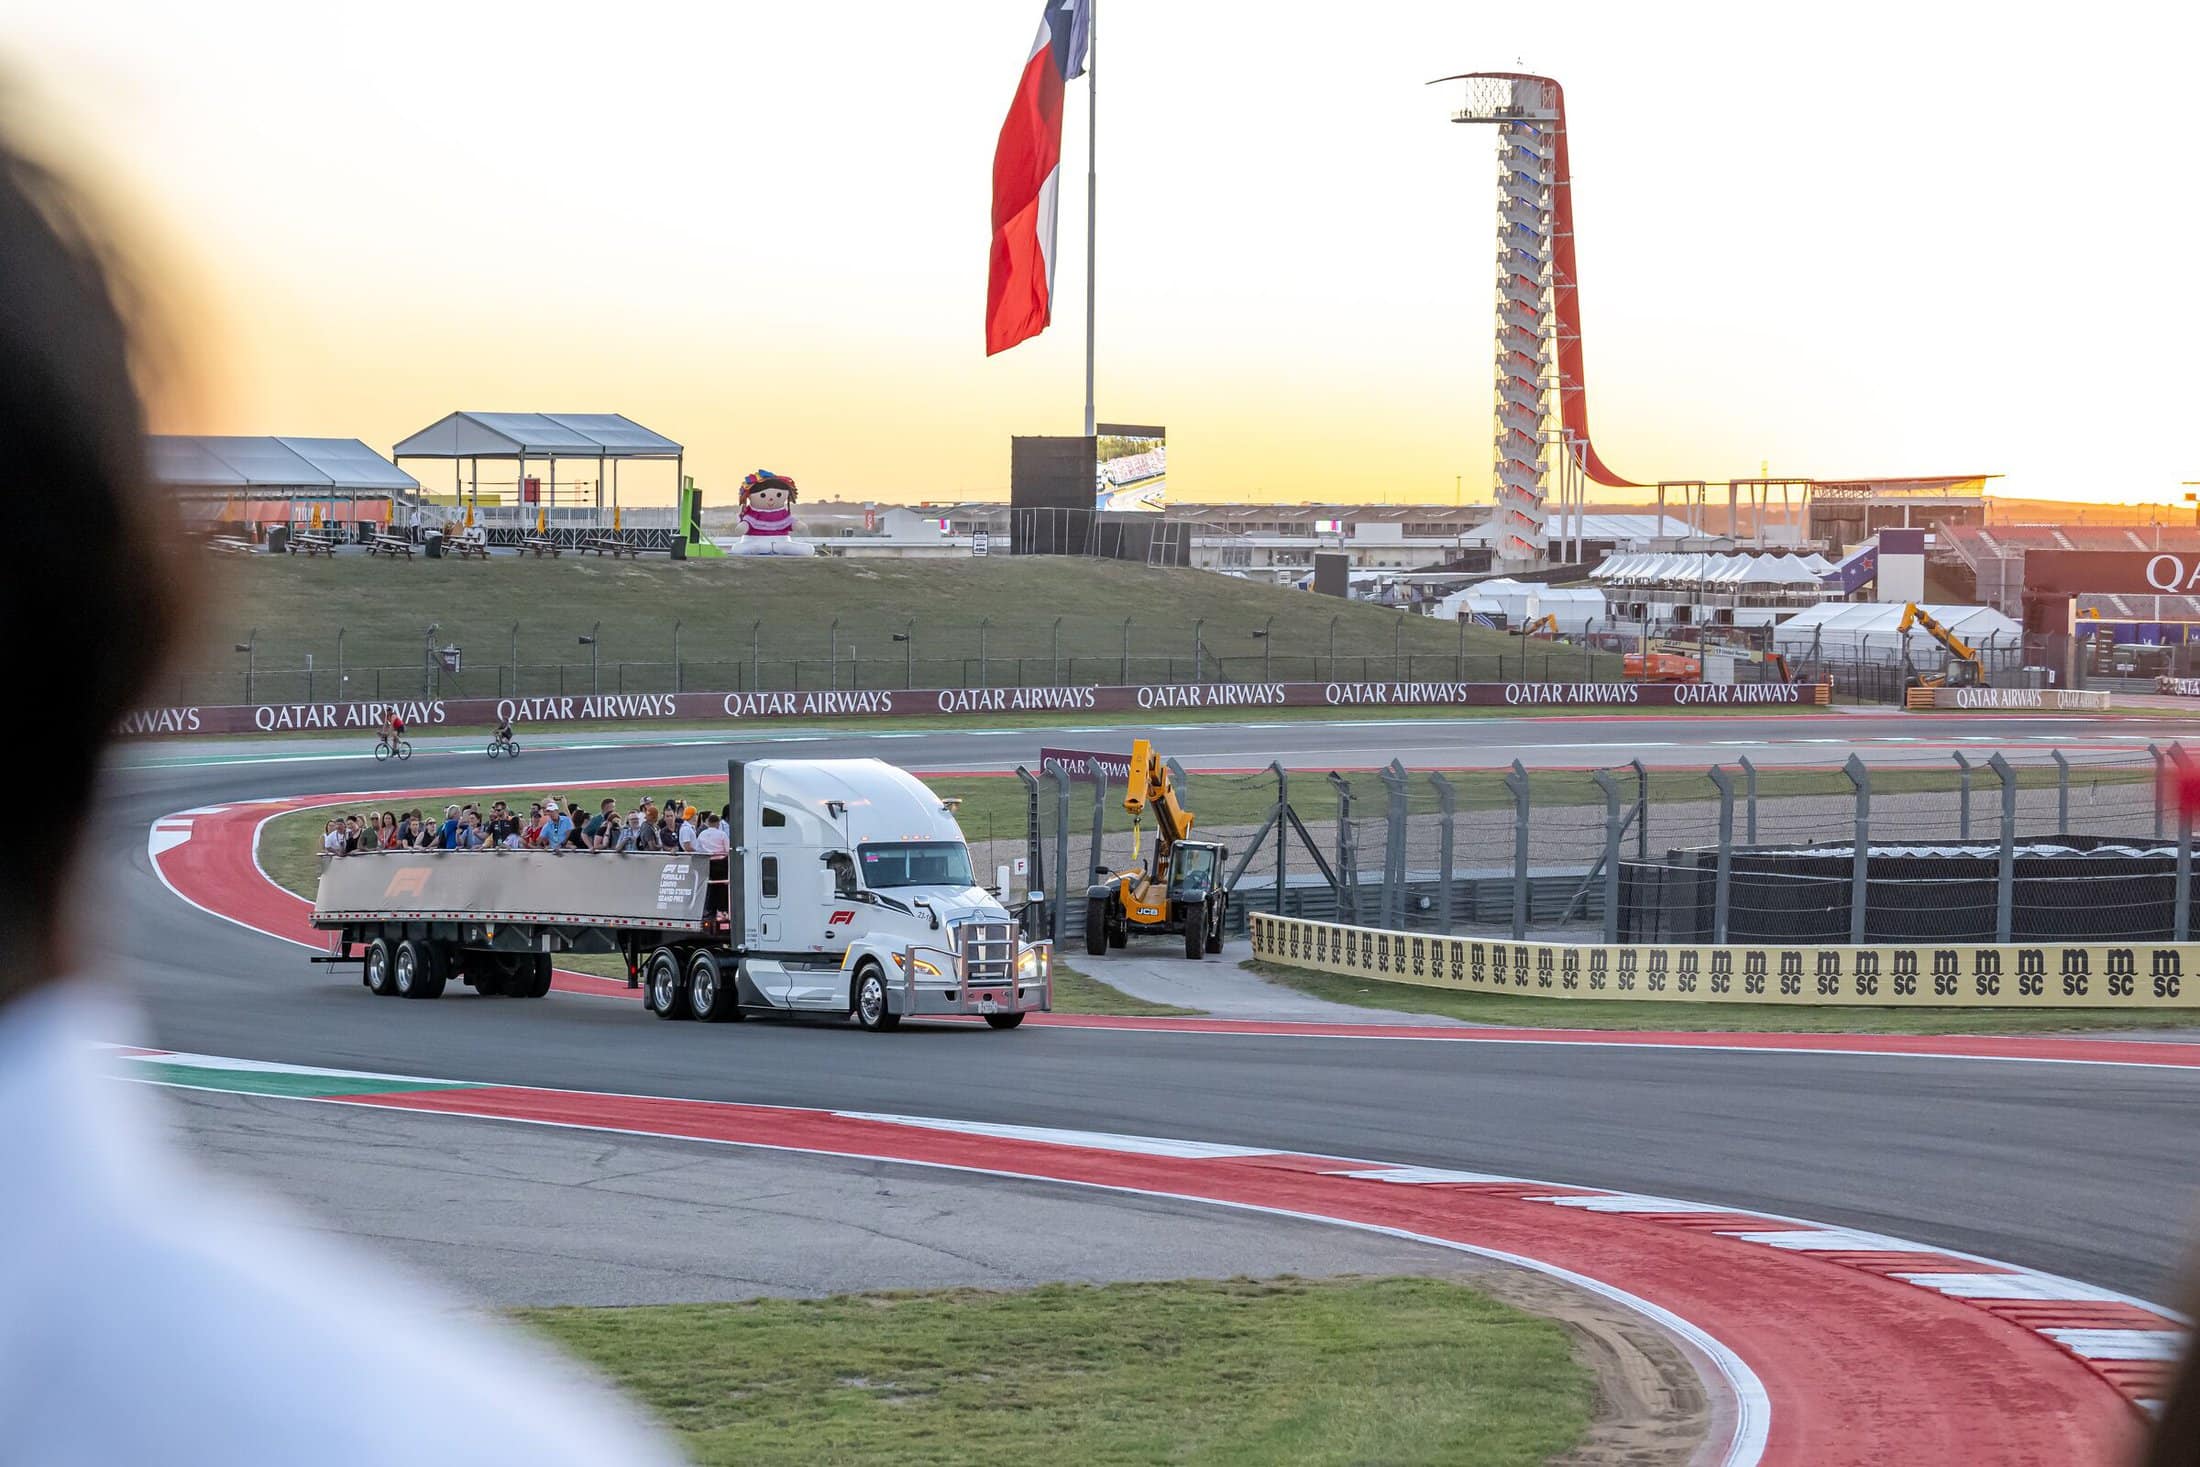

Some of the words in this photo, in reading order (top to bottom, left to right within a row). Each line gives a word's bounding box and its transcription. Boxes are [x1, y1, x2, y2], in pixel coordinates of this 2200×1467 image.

[723, 692, 796, 716] QATAR
[803, 690, 893, 713] AIRWAYS
[938, 689, 1006, 712] QATAR
[1011, 687, 1096, 708] AIRWAYS
[1137, 685, 1201, 708] QATAR
[1206, 684, 1285, 705] AIRWAYS
[1325, 684, 1387, 704] QATAR
[1391, 683, 1467, 702] AIRWAYS
[1505, 683, 1563, 703] QATAR
[1567, 683, 1638, 702] AIRWAYS
[1674, 683, 1728, 703] QATAR
[1732, 683, 1799, 702] AIRWAYS
[1956, 689, 1998, 708] QATAR
[2002, 690, 2041, 707] AIRWAYS
[255, 705, 337, 731] QATAR
[497, 700, 575, 723] QATAR
[580, 695, 676, 717] AIRWAYS
[1017, 861, 1024, 871] F
[828, 911, 855, 924] F1
[1137, 908, 1158, 916] JCB
